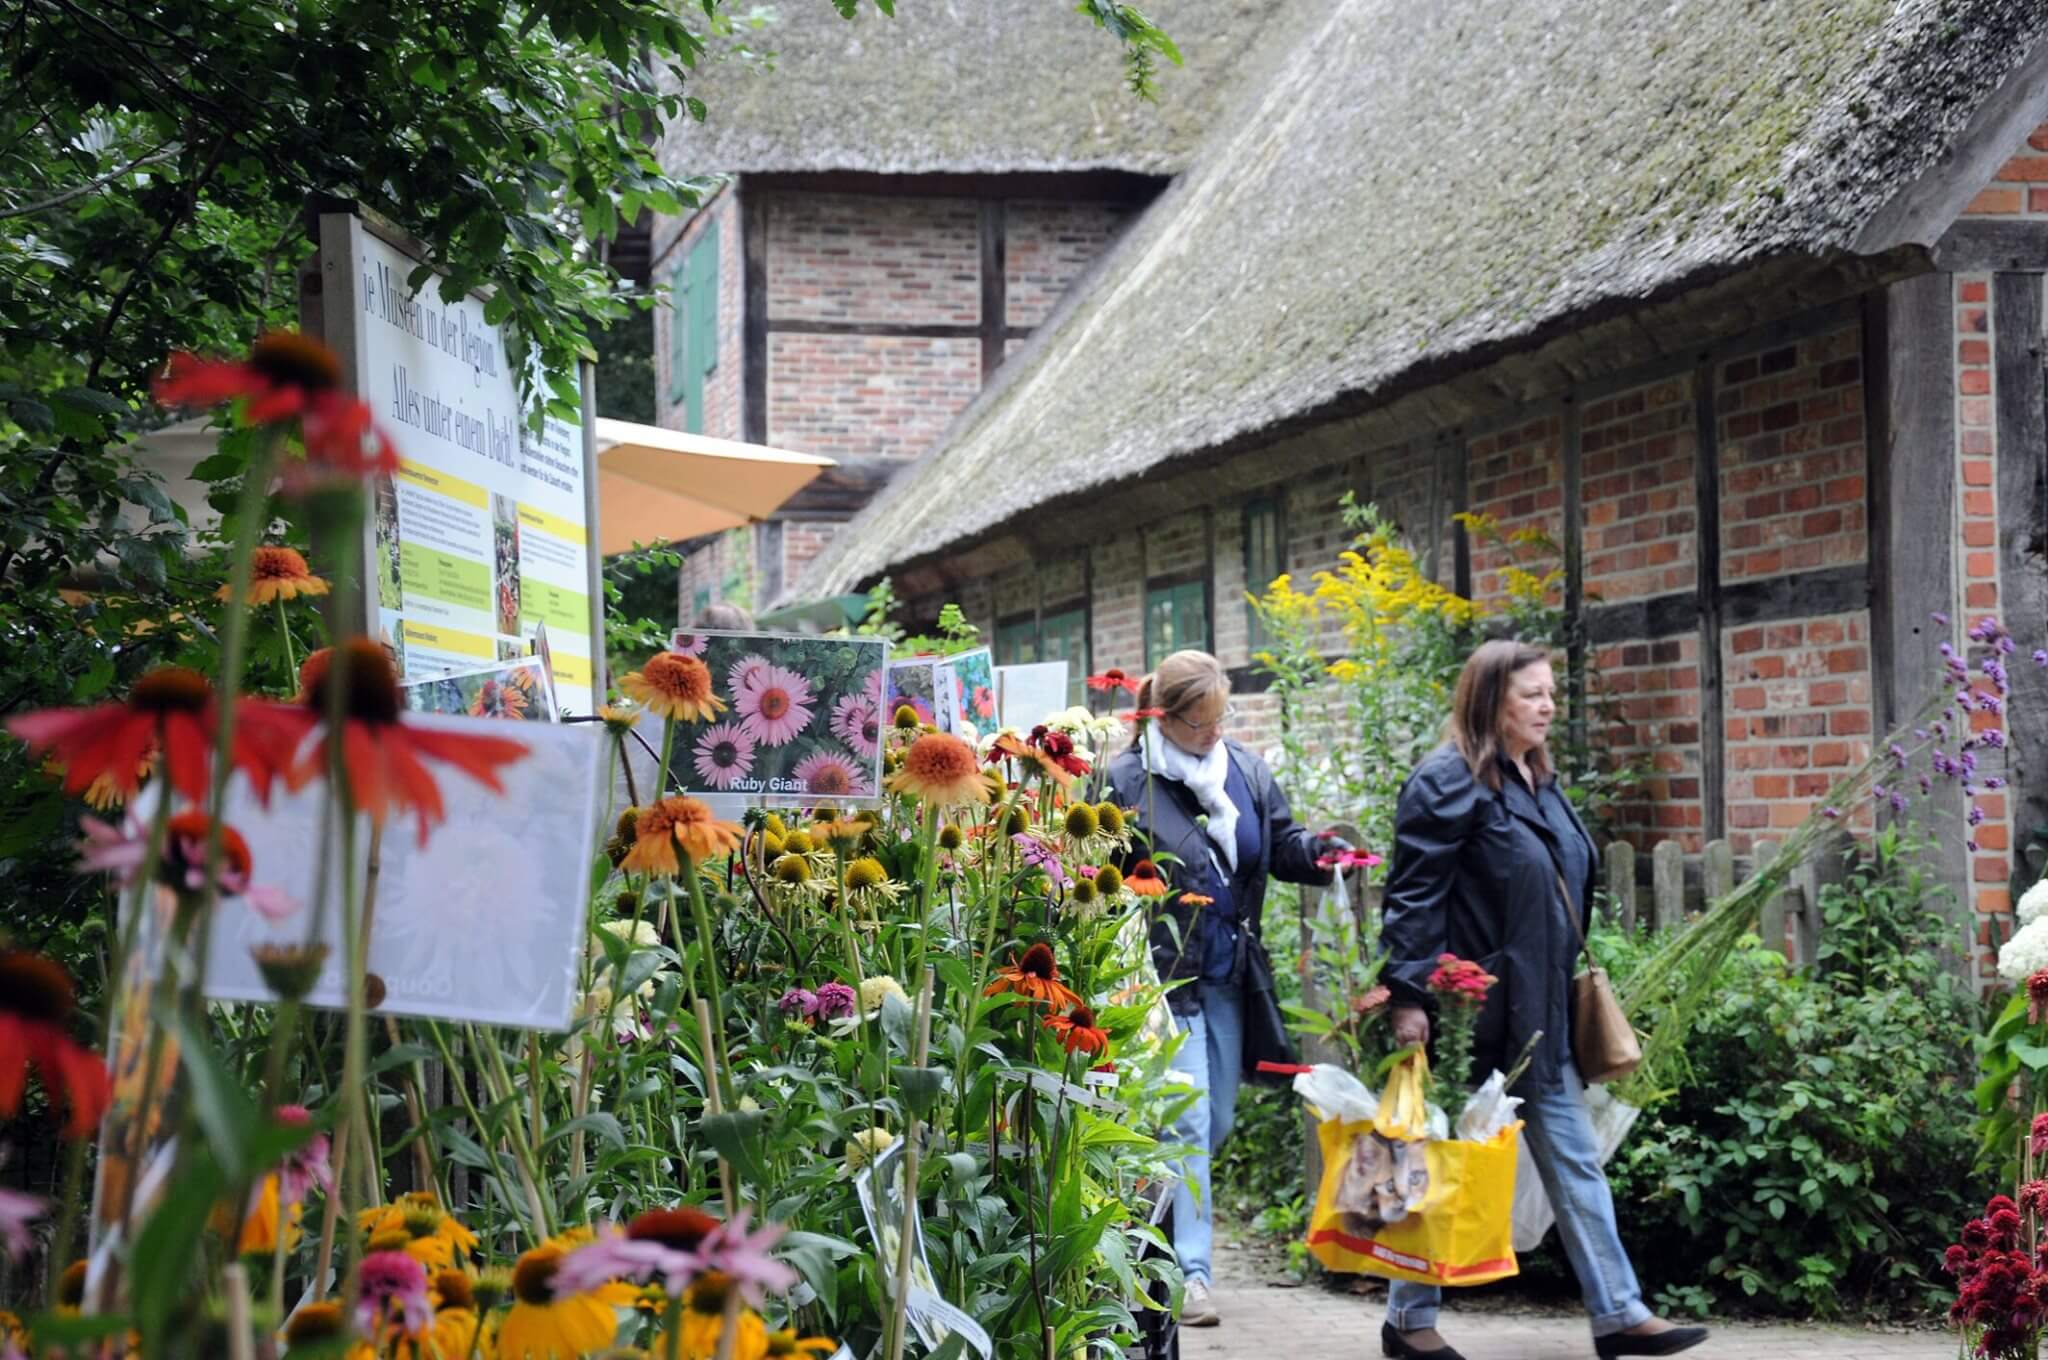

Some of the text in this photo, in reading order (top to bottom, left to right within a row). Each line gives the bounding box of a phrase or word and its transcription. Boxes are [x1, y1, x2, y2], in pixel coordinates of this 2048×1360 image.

[363, 256, 498, 389] ie Museen in der Region.
[392, 362, 421, 429] Alles
[422, 391, 452, 441] unter
[455, 396, 487, 456] einem
[730, 776, 808, 794] Ruby Giant
